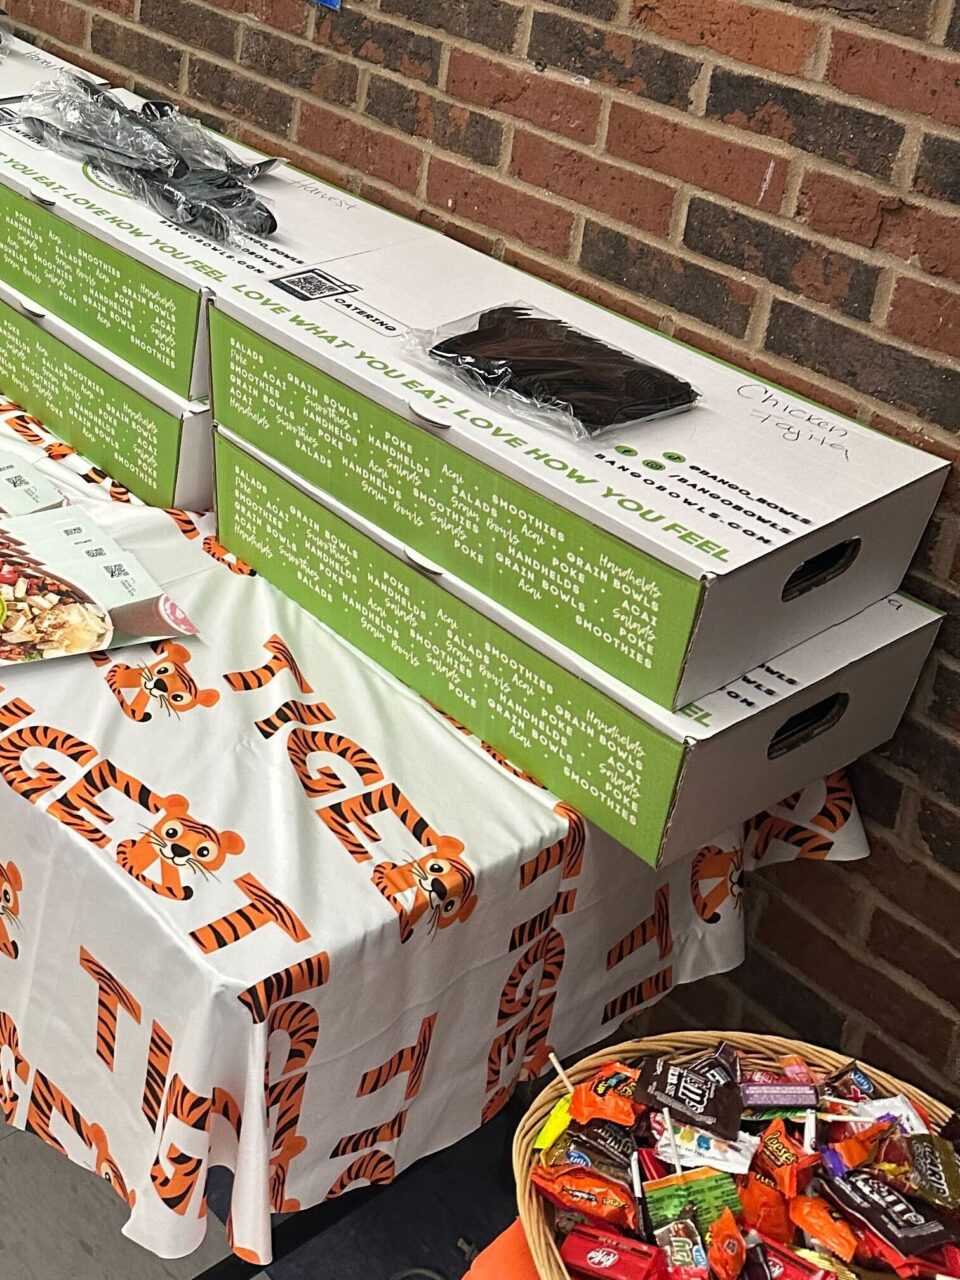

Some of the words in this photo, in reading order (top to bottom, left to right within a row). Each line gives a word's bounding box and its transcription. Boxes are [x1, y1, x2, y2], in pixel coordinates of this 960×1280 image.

[3, 157, 36, 179] YOU
[30, 173, 62, 194] EAT,
[61, 188, 108, 217] LOVE
[104, 213, 148, 243] HOW
[148, 238, 189, 265] YOU
[185, 258, 227, 283] FEEL
[14, 210, 31, 227] POKE
[78, 247, 120, 279] SMOOTHIES
[159, 220, 266, 275] BANGOBOWLS.COM
[330, 297, 400, 332] CATERING
[229, 283, 293, 315] LOVE
[283, 314, 357, 351] WHAT
[348, 350, 407, 380] YOU
[396, 378, 458, 409] EAT,
[450, 407, 530, 449] LOVE
[522, 447, 600, 487] HOW
[594, 485, 666, 523] YOU
[661, 521, 740, 563] FEEL
[229, 373, 258, 398] GRAIN
[263, 393, 294, 421] BOWLS
[318, 428, 343, 451] POKE
[413, 487, 478, 534] SMOOTHIES
[508, 544, 580, 595] HANDHELDS
[229, 384, 252, 406] ACAI
[342, 455, 401, 500] HANDHELDS
[495, 550, 534, 582] GRAIN
[541, 579, 586, 613] BOWLS
[618, 627, 654, 655] POKE
[230, 336, 263, 364] SALADS
[287, 372, 318, 397] GRAIN
[323, 394, 358, 422] BOWLS
[384, 430, 412, 454] POKE
[492, 493, 565, 543] SMOOTHIES
[230, 361, 279, 398] SMOOTHIES
[303, 406, 357, 447] HANDHELDS
[551, 556, 585, 584] POKE
[621, 598, 658, 627] ACAI
[263, 369, 286, 391] ACAI
[368, 433, 430, 478] HANDHELDS
[452, 484, 498, 518] SALADS
[566, 551, 608, 583] GRAIN
[612, 578, 659, 612] BOWLS
[593, 451, 773, 546] BANGOBOWLS.COM
[666, 471, 794, 536] /BANGOBOWLS
[686, 462, 813, 527] @BANGO_BOWLS
[235, 465, 267, 495] SALADS
[290, 504, 319, 532] GRAIN
[324, 529, 358, 560] BOWLS
[382, 570, 409, 596] POKE
[484, 640, 554, 695] SMOOTHIES
[266, 499, 289, 523] ACAI
[367, 571, 426, 621] HANDHELDS
[447, 628, 490, 666] SALADS
[555, 703, 594, 738] GRAIN
[599, 734, 643, 771] BOWLS
[295, 439, 331, 469] SALADS
[454, 539, 484, 564] POKE
[574, 614, 653, 670] SMOOTHIES
[222, 632, 477, 944] TIGER
